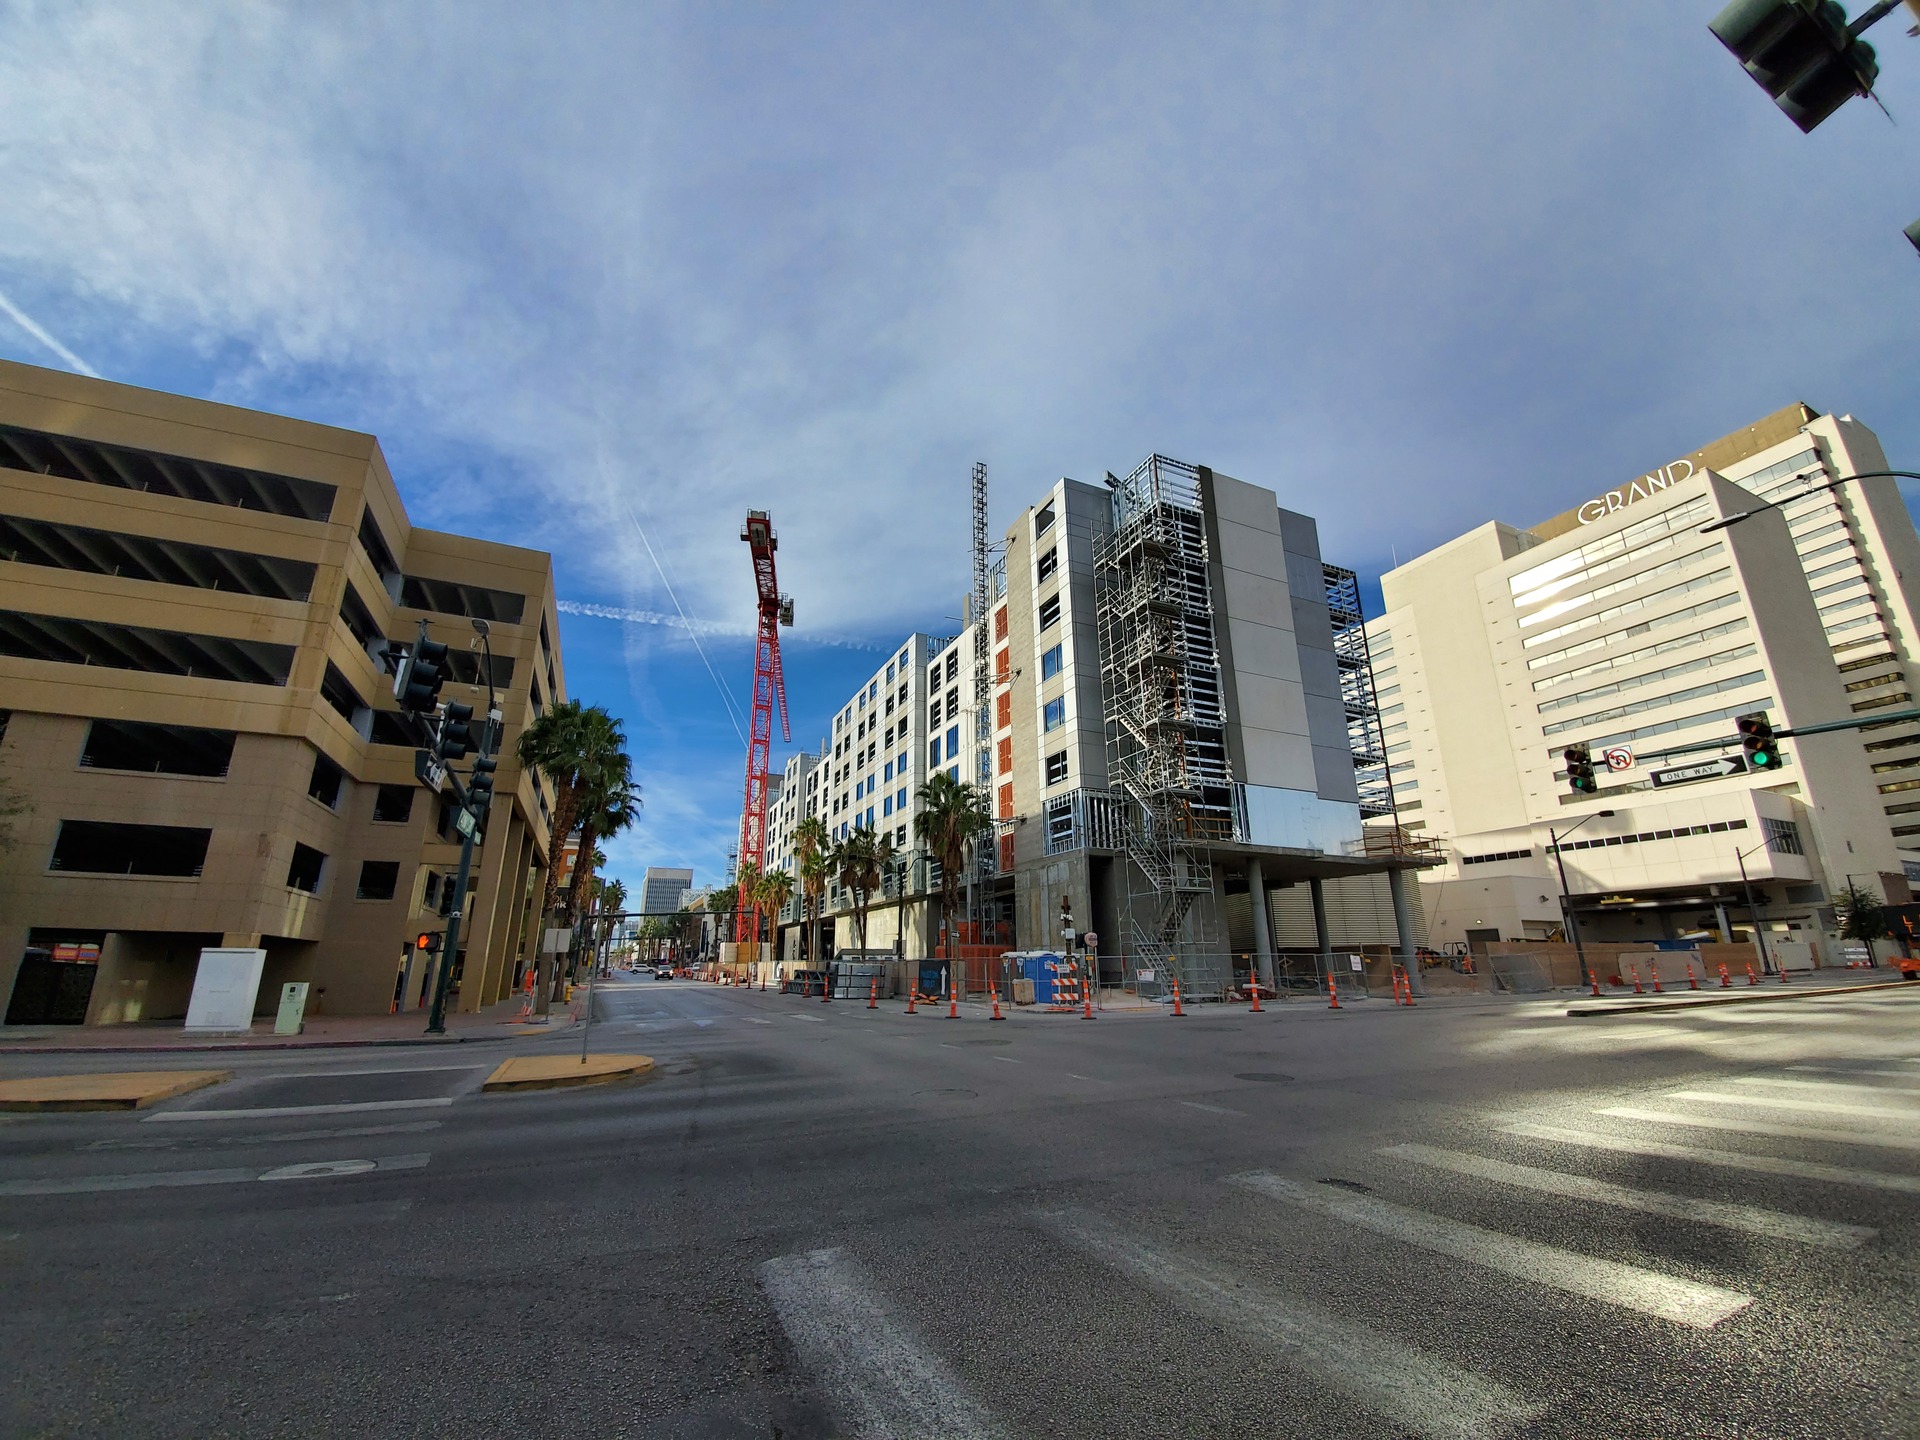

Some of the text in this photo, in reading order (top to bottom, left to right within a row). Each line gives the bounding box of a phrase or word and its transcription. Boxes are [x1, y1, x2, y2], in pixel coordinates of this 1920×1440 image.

[1577, 459, 1694, 526] GRAND
[1667, 766, 1714, 780] ONE WAY
